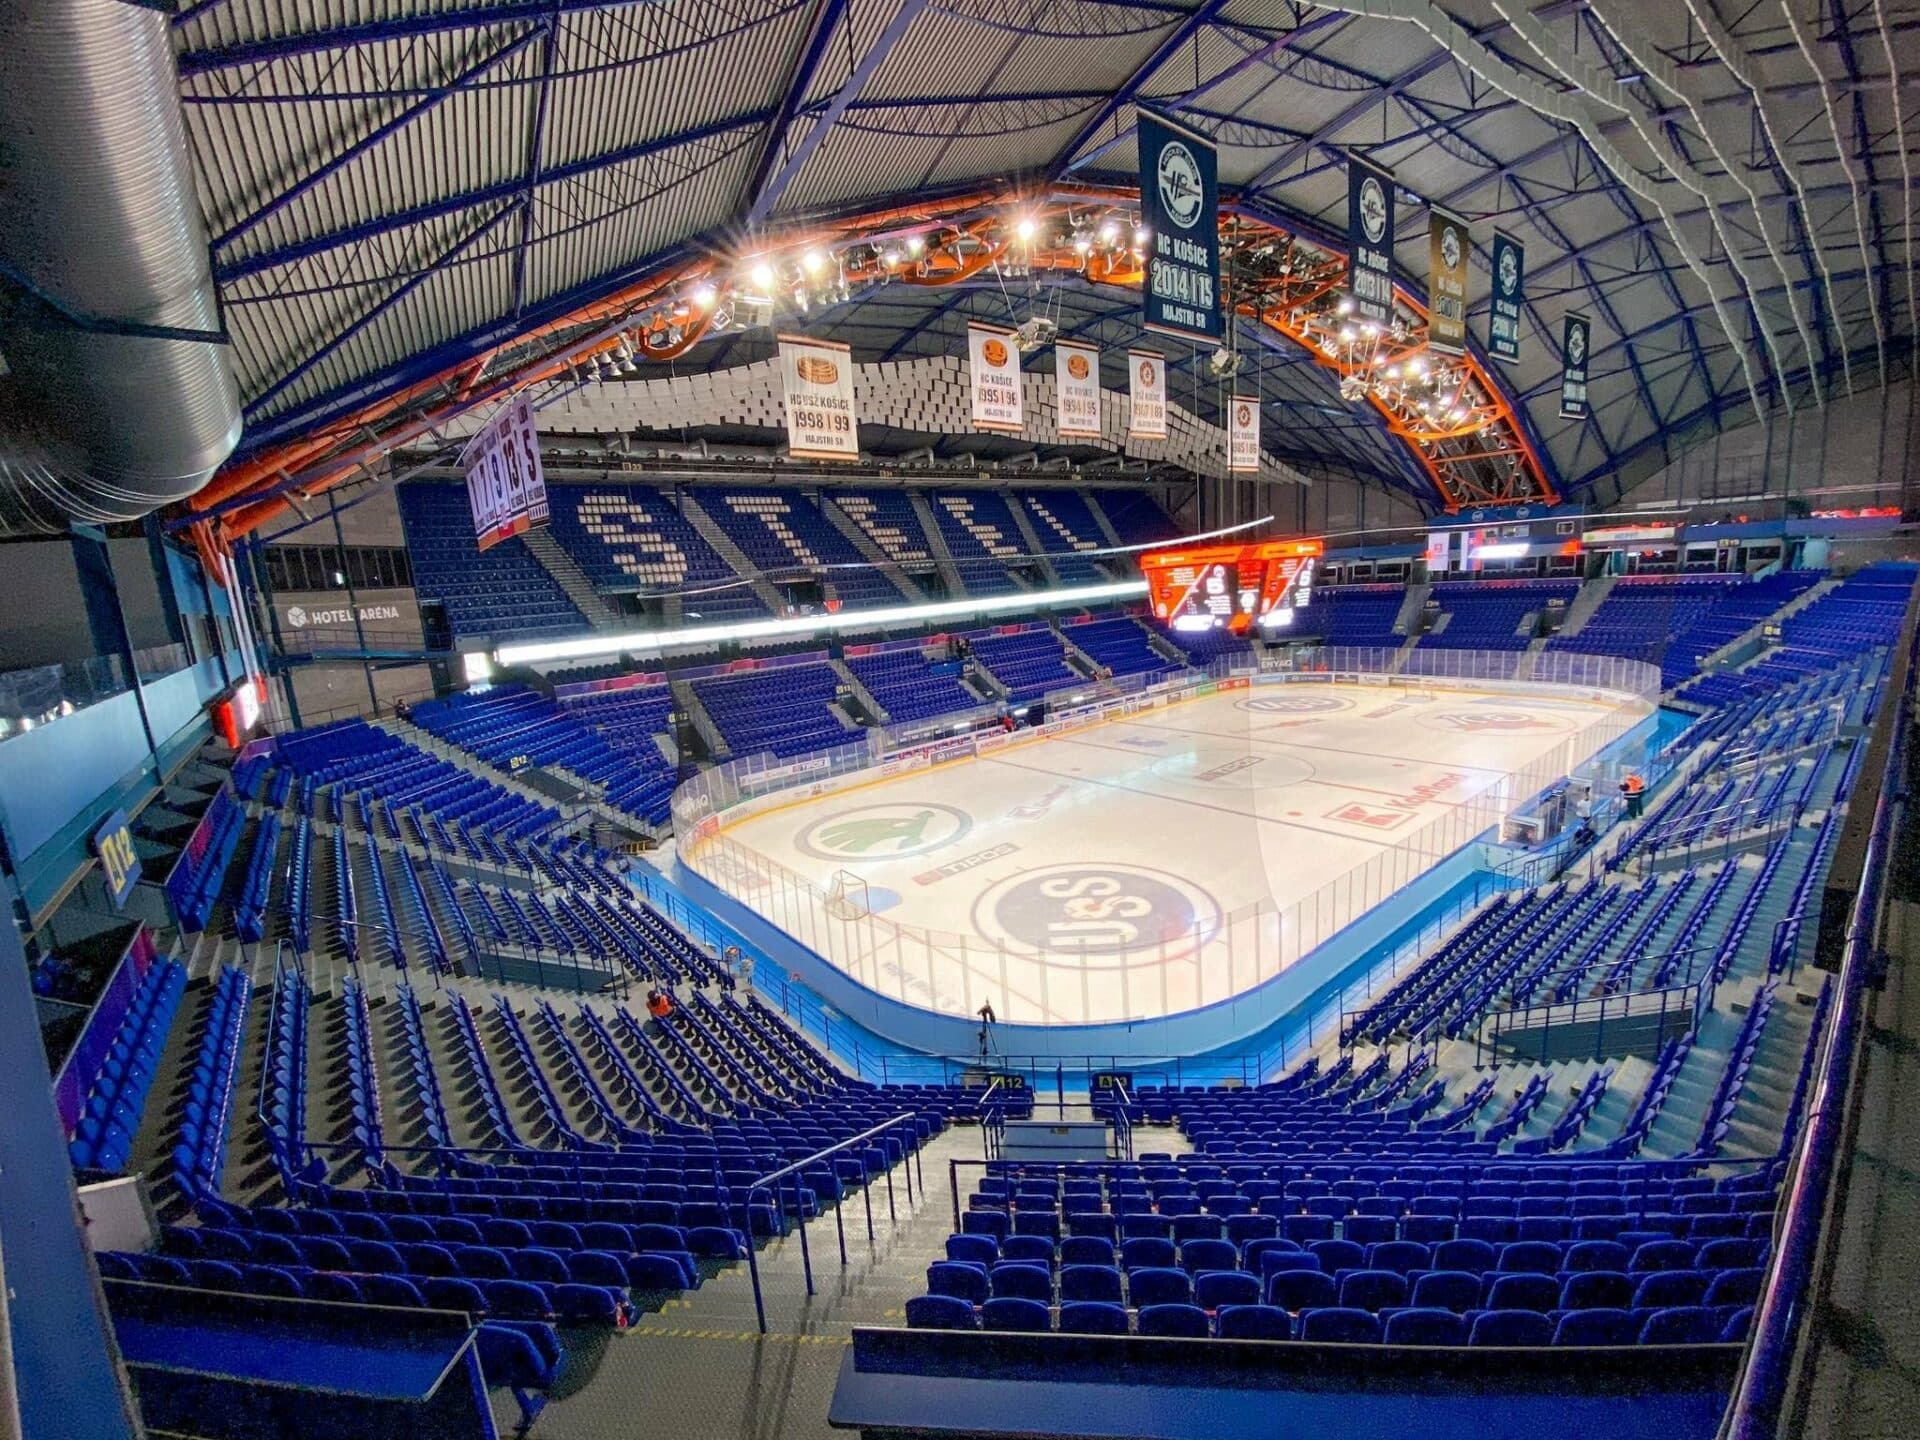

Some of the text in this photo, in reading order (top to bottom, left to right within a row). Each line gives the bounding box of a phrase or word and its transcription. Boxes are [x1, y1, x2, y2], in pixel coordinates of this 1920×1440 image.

[1157, 232, 1209, 268] HC KOŠICE
[1162, 303, 1206, 329] MAJSTRI SR
[820, 395, 850, 411] KOŠICE
[311, 606, 400, 625] HOTEL ARÉNA
[1006, 1077, 1022, 1089] 12
